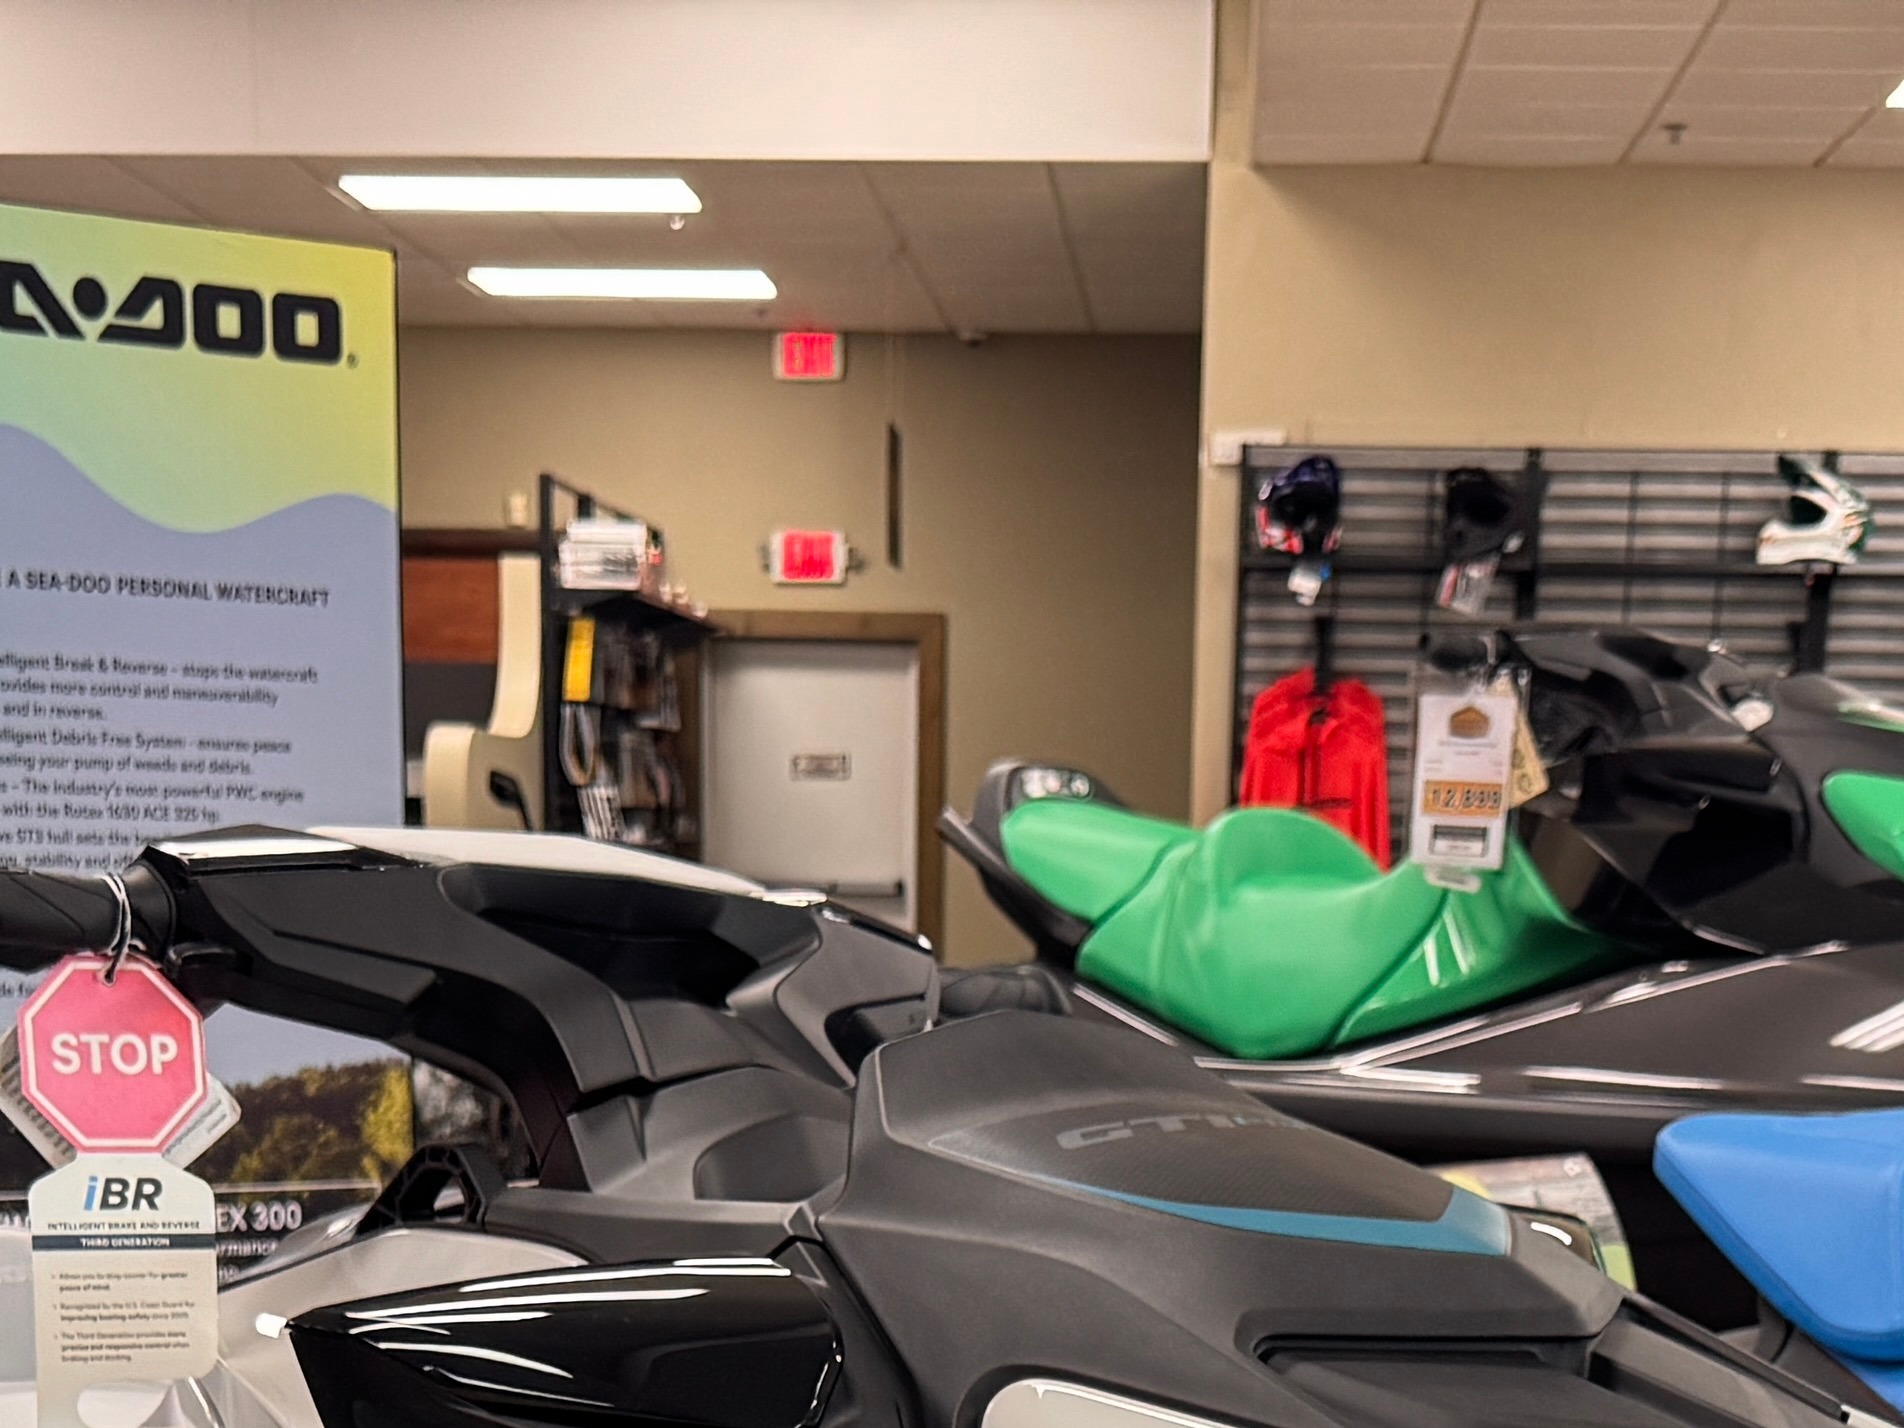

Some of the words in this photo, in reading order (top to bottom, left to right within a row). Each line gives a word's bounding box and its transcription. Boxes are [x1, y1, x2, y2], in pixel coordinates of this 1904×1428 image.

[6, 569, 21, 588] A
[25, 571, 111, 594] SEA-DOO
[117, 576, 212, 600] PERSONAL
[215, 581, 329, 608] WATERCRAFT
[50, 1033, 179, 1076] STOP
[84, 1176, 163, 1211] iBR
[48, 1221, 105, 1231] INTELLIGENT
[108, 1222, 137, 1231] BRAKE
[140, 1221, 159, 1230] AND
[161, 1220, 200, 1230] REVERSE
[250, 1200, 303, 1232] 300
[80, 1237, 109, 1248] THIRD
[111, 1236, 170, 1247] GENERATION
